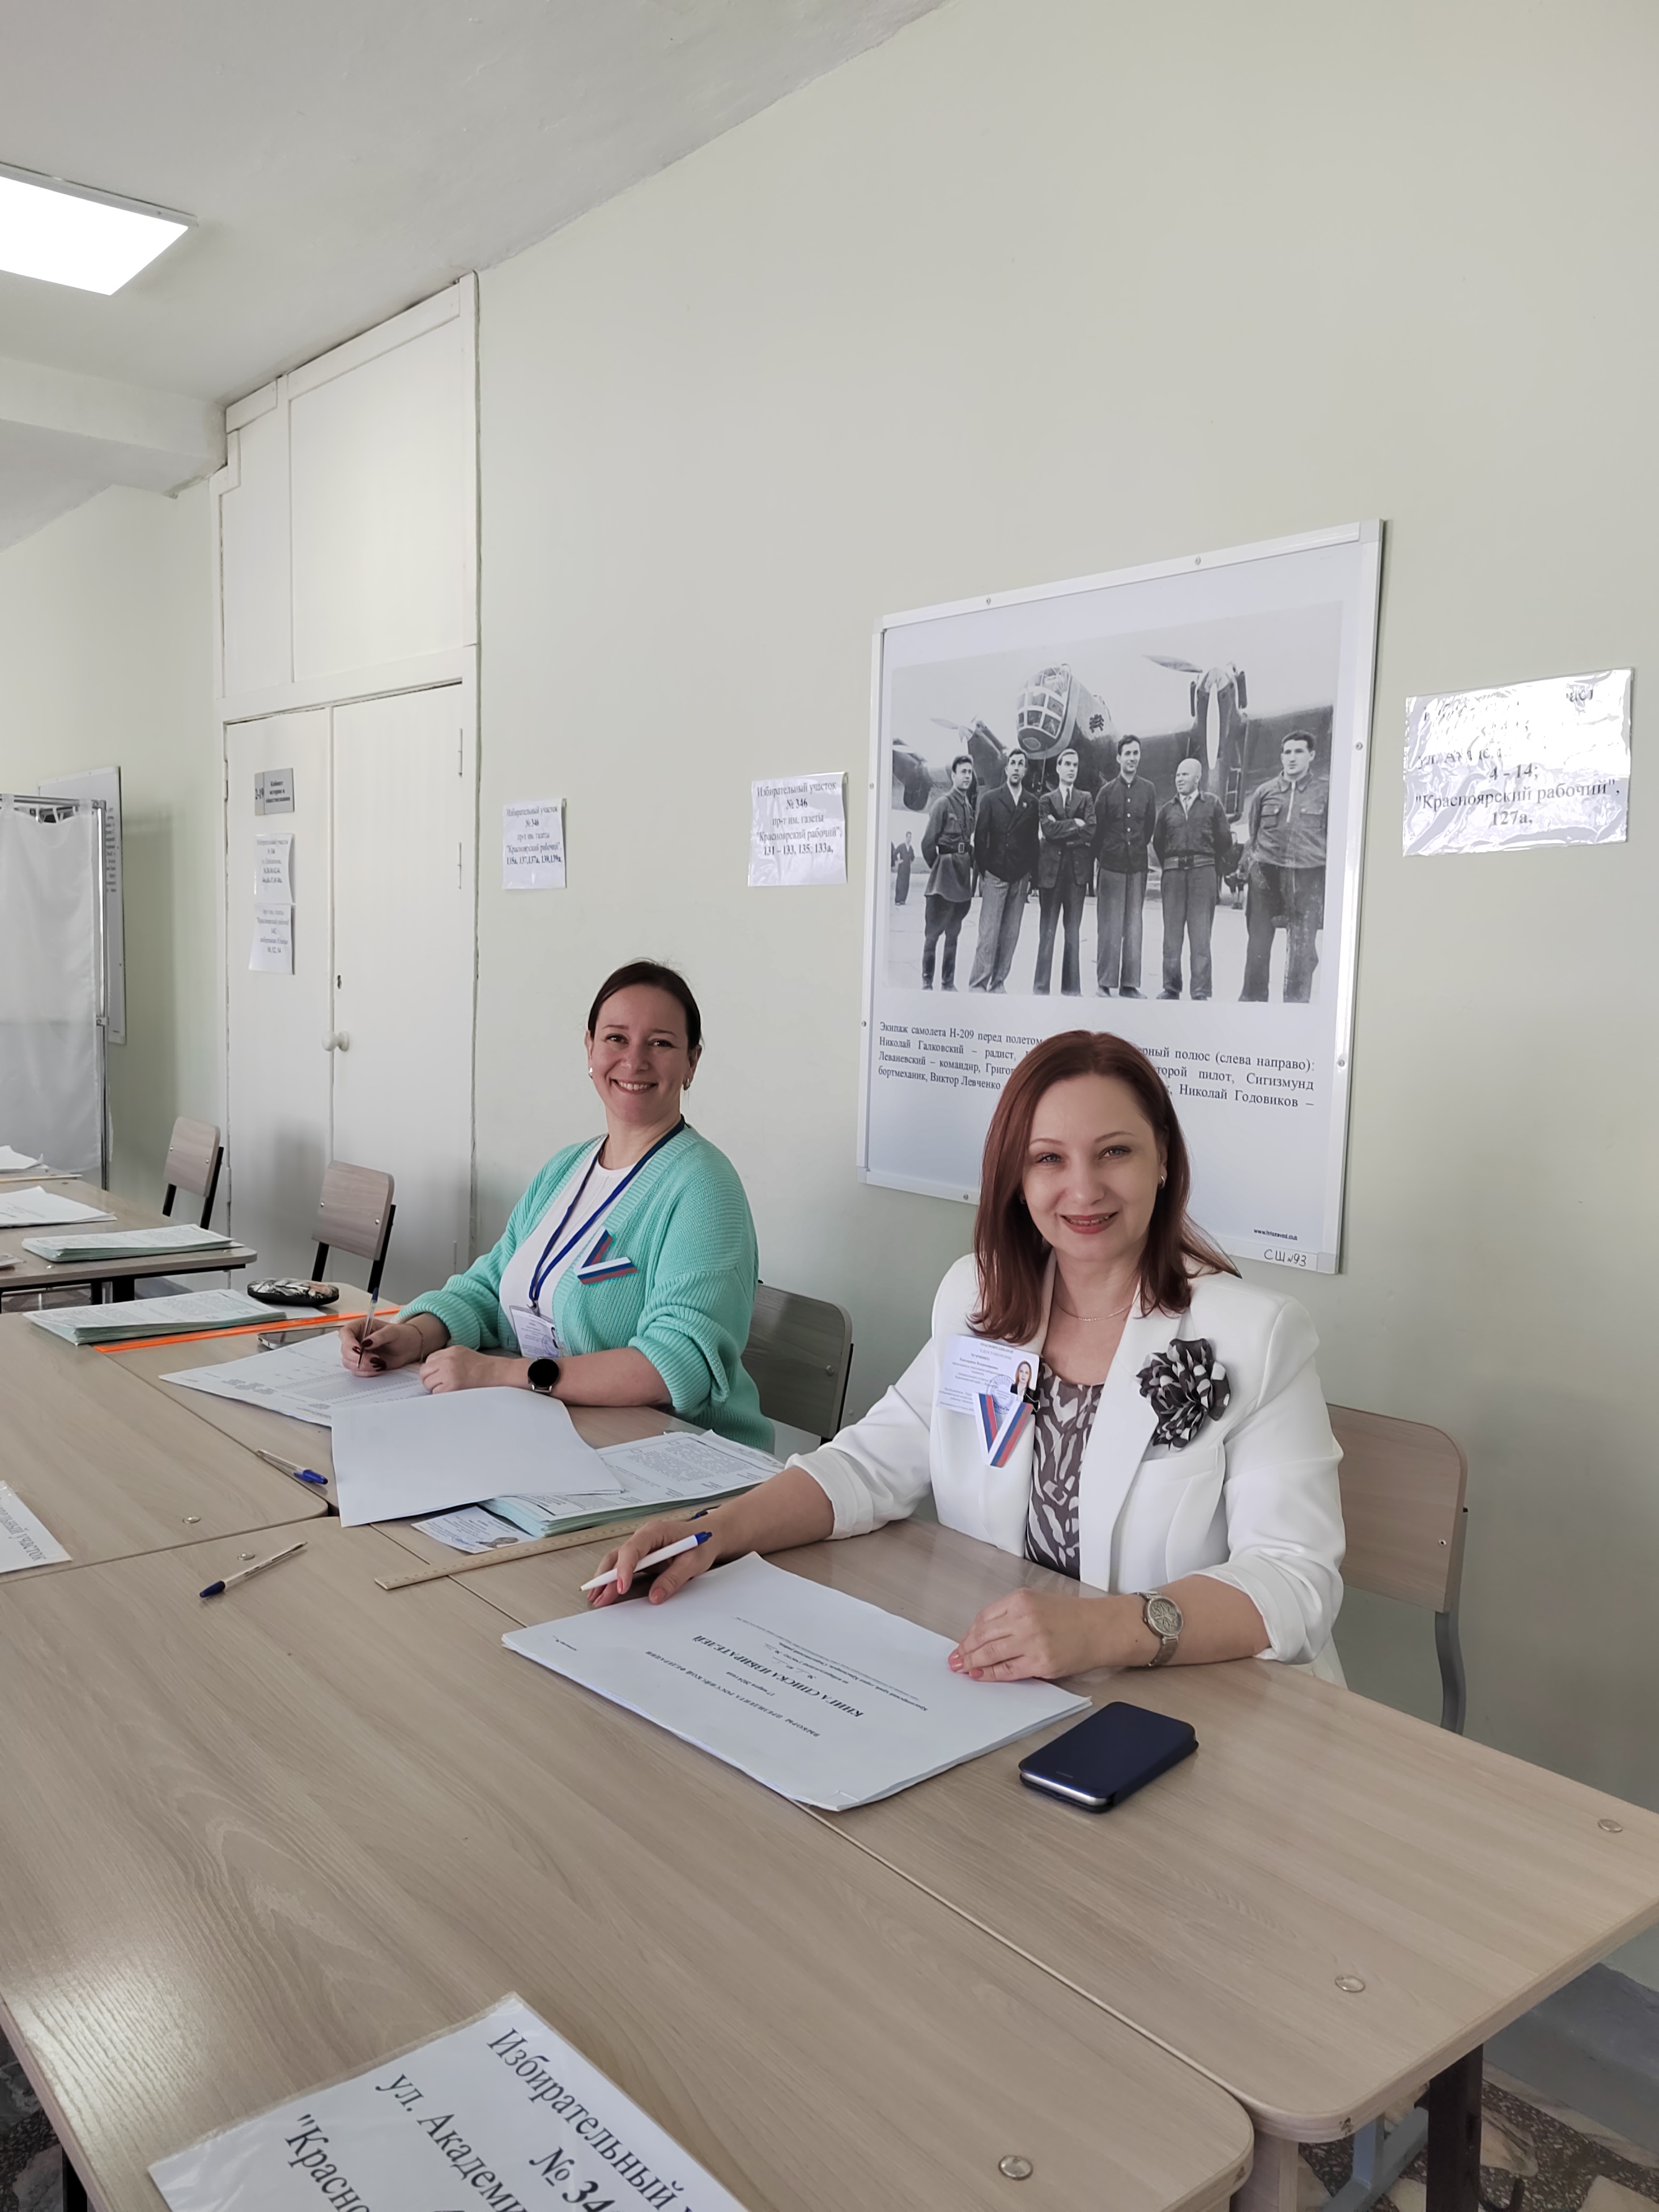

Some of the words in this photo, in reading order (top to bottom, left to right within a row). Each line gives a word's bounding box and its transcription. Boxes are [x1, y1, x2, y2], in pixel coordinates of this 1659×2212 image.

[1489, 766, 1498, 781] 4
[1516, 763, 1538, 780] 14;
[1416, 785, 1531, 812] "Красноярский
[1492, 810, 1533, 826] 127а,
[879, 1022, 908, 1033] Экипаж
[911, 1026, 946, 1037] самолета
[950, 1028, 974, 1039] Н-209
[978, 1033, 1002, 1043] перед
[1175, 1050, 1210, 1062] полюс
[1215, 1051, 1251, 1065] (слева
[1257, 1058, 1315, 1073] направо):
[879, 1037, 911, 1049] Николай
[918, 1040, 964, 1054] Галковский
[985, 1049, 1016, 1061] радист,
[1156, 1066, 1188, 1079] торой
[1199, 1070, 1235, 1084] пилот,
[1247, 1073, 1314, 1091] Сигизмунд
[878, 1066, 928, 1082] бортмеханик,
[930, 1072, 959, 1087] Виктор
[961, 1075, 1001, 1090] Левченко
[878, 1051, 926, 1065] Леваневский
[939, 1059, 981, 1073] командир,
[986, 1062, 1015, 1076] Григор
[1179, 1083, 1227, 1100] Николай
[1235, 1090, 1299, 1107] Годовиков
[692, 1635, 771, 1674] ИЗБИРАТЕЛЕЙ
[772, 1672, 820, 1695] СПИСКА
[821, 1694, 863, 1717] КНИГА
[375, 2074, 424, 2112] ул.
[487, 2027, 684, 2211] Избирательный
[529, 2146, 575, 2187] №
[562, 2180, 619, 2212] 34
